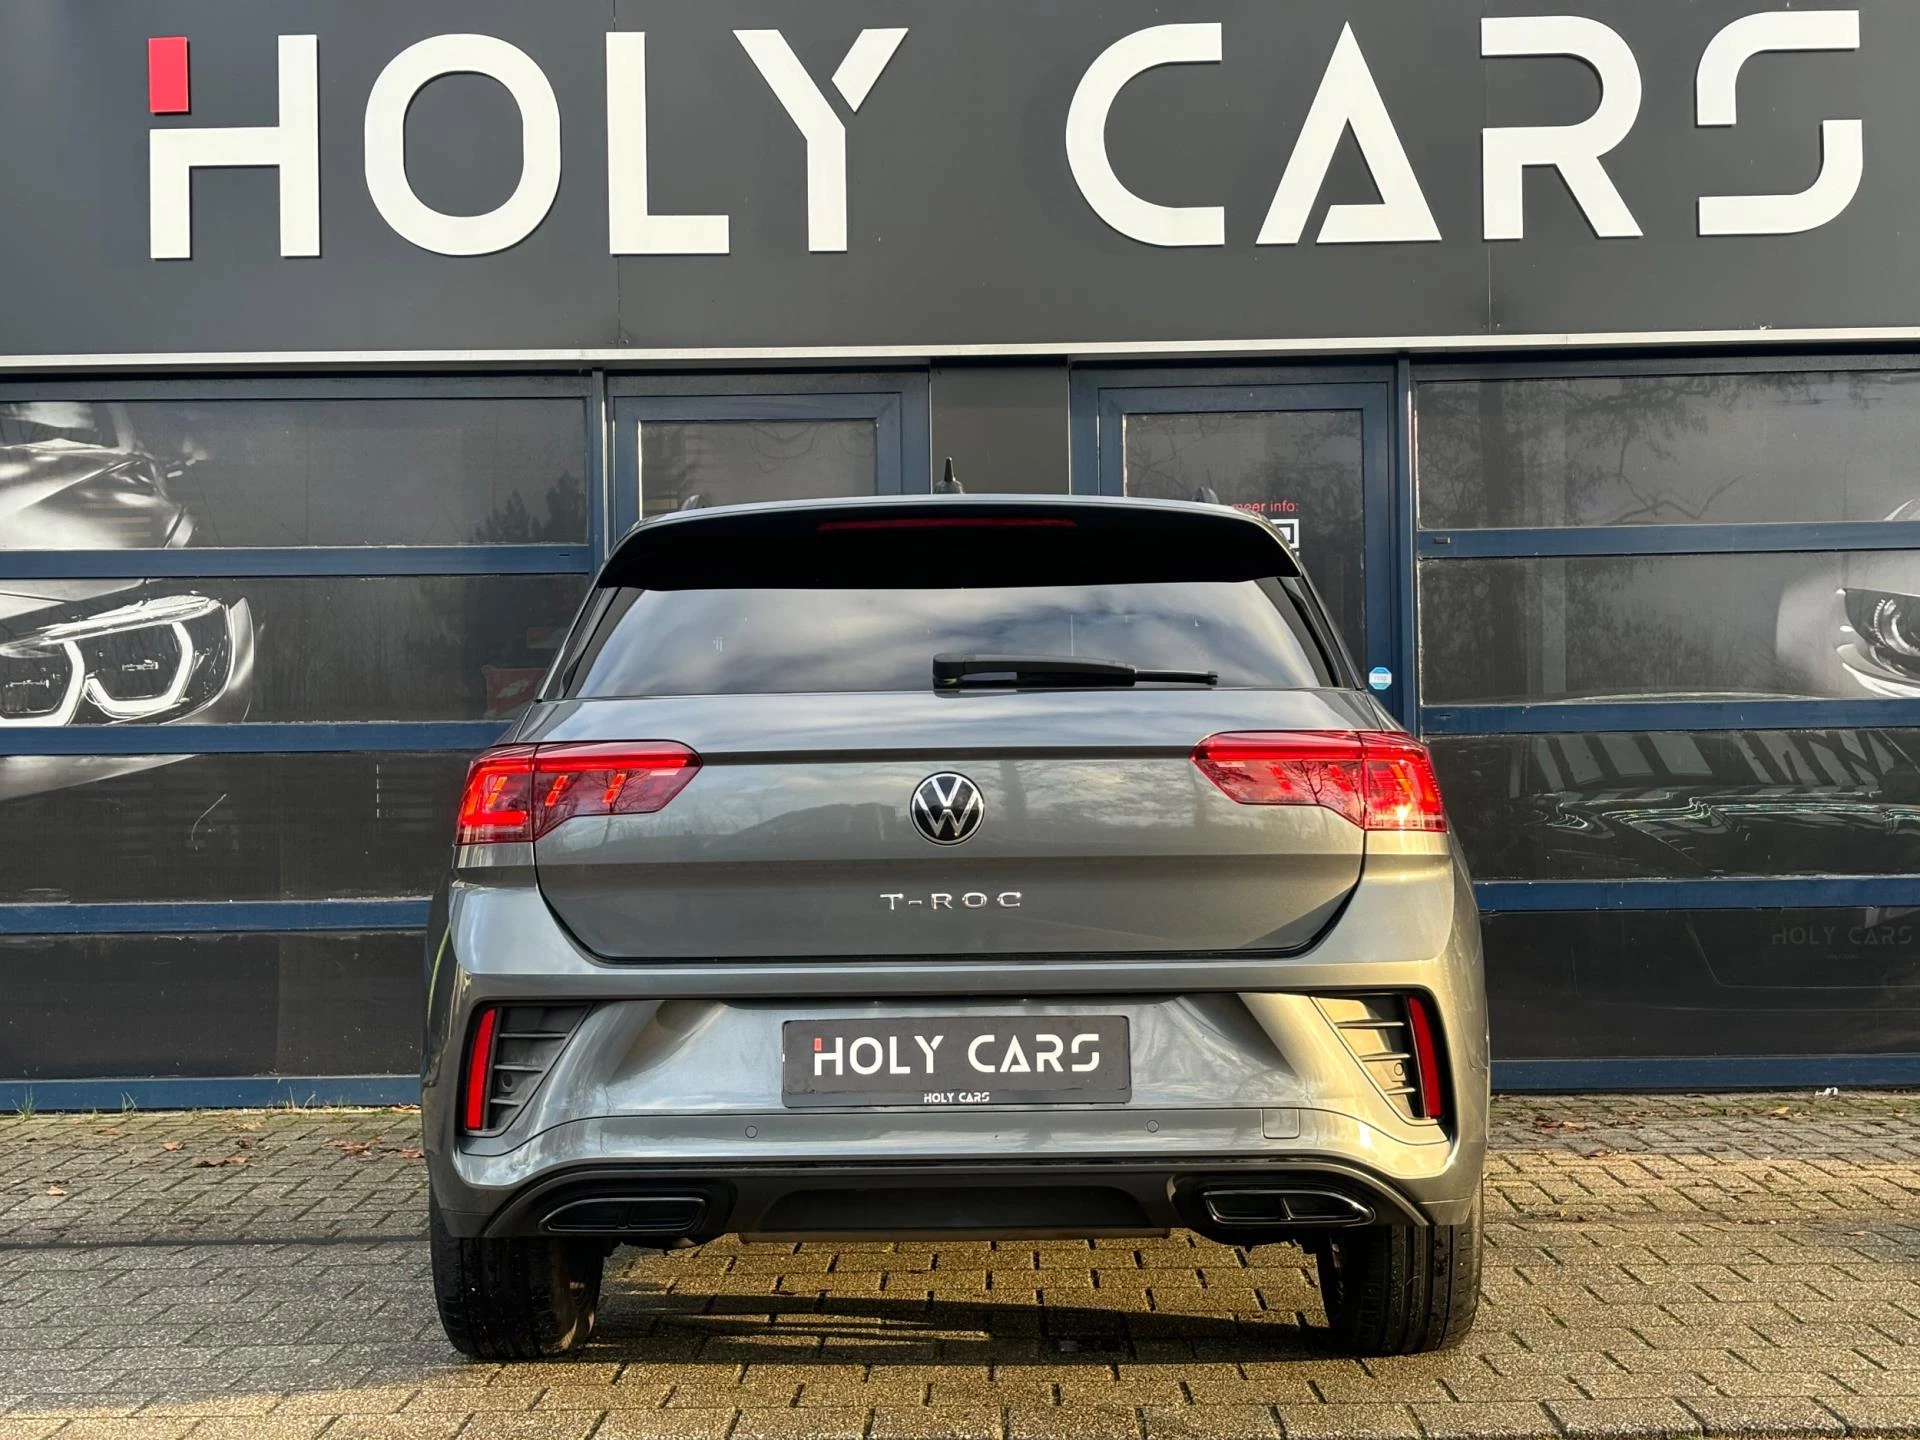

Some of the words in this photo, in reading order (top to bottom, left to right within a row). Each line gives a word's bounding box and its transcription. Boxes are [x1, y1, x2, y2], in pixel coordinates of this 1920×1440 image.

[148, 28, 909, 259] HOLY
[1065, 10, 1863, 247] CARS
[1271, 500, 1299, 512] info:
[880, 892, 1022, 910] T-ROC
[1771, 926, 1837, 945] HOLY
[1847, 926, 1913, 945] CARS
[813, 1035, 945, 1076] HOLY
[967, 1033, 1100, 1073] CARS
[923, 1092, 955, 1103] HOLY
[958, 1091, 990, 1103] CARS
